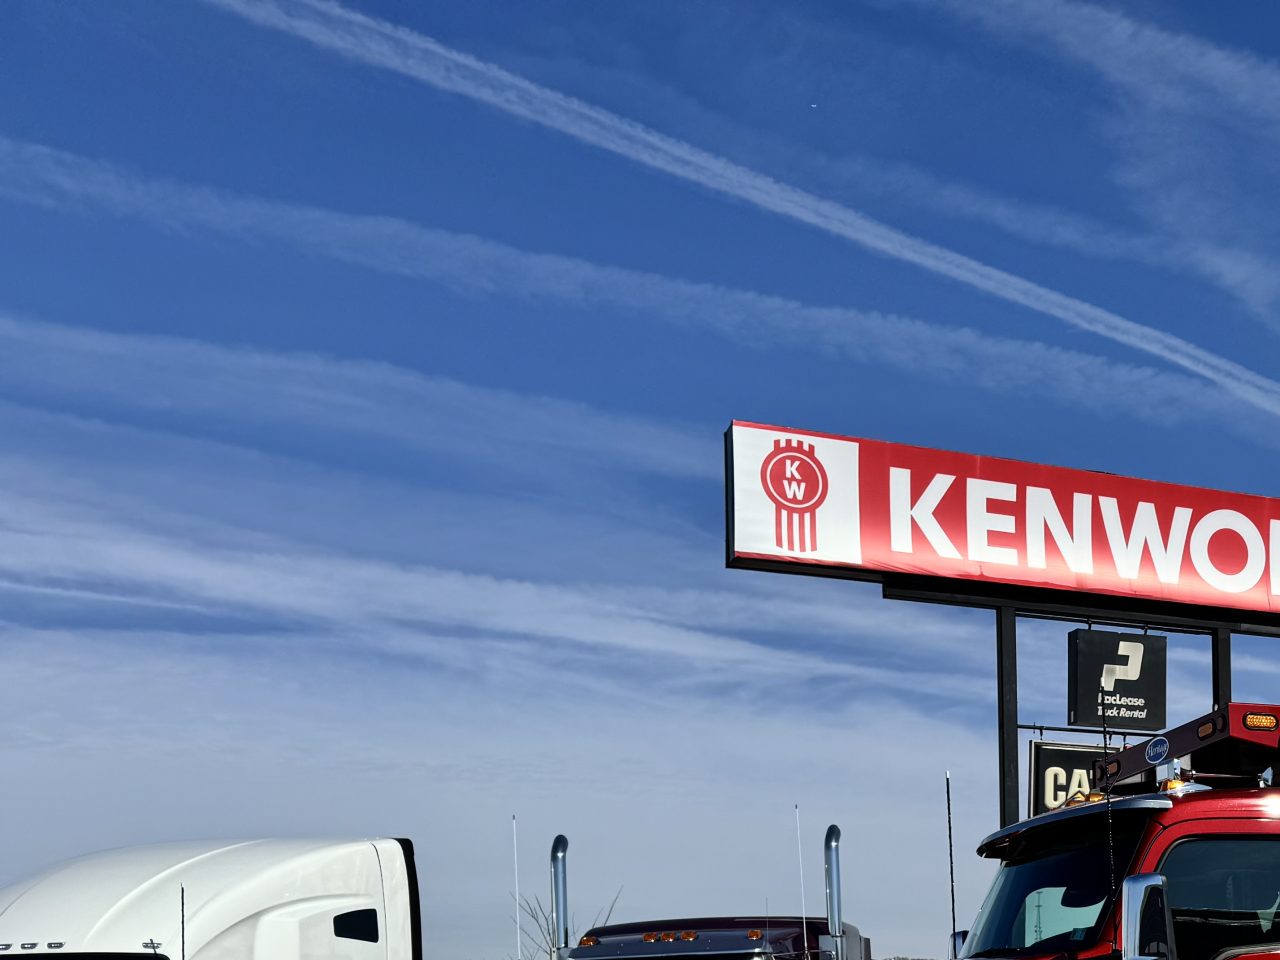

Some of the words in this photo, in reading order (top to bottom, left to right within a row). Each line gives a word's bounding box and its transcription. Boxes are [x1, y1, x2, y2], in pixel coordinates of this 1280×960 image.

[1097, 705, 1119, 718] Tuck
[1119, 707, 1148, 719] Rental
[1044, 766, 1094, 810] CA
